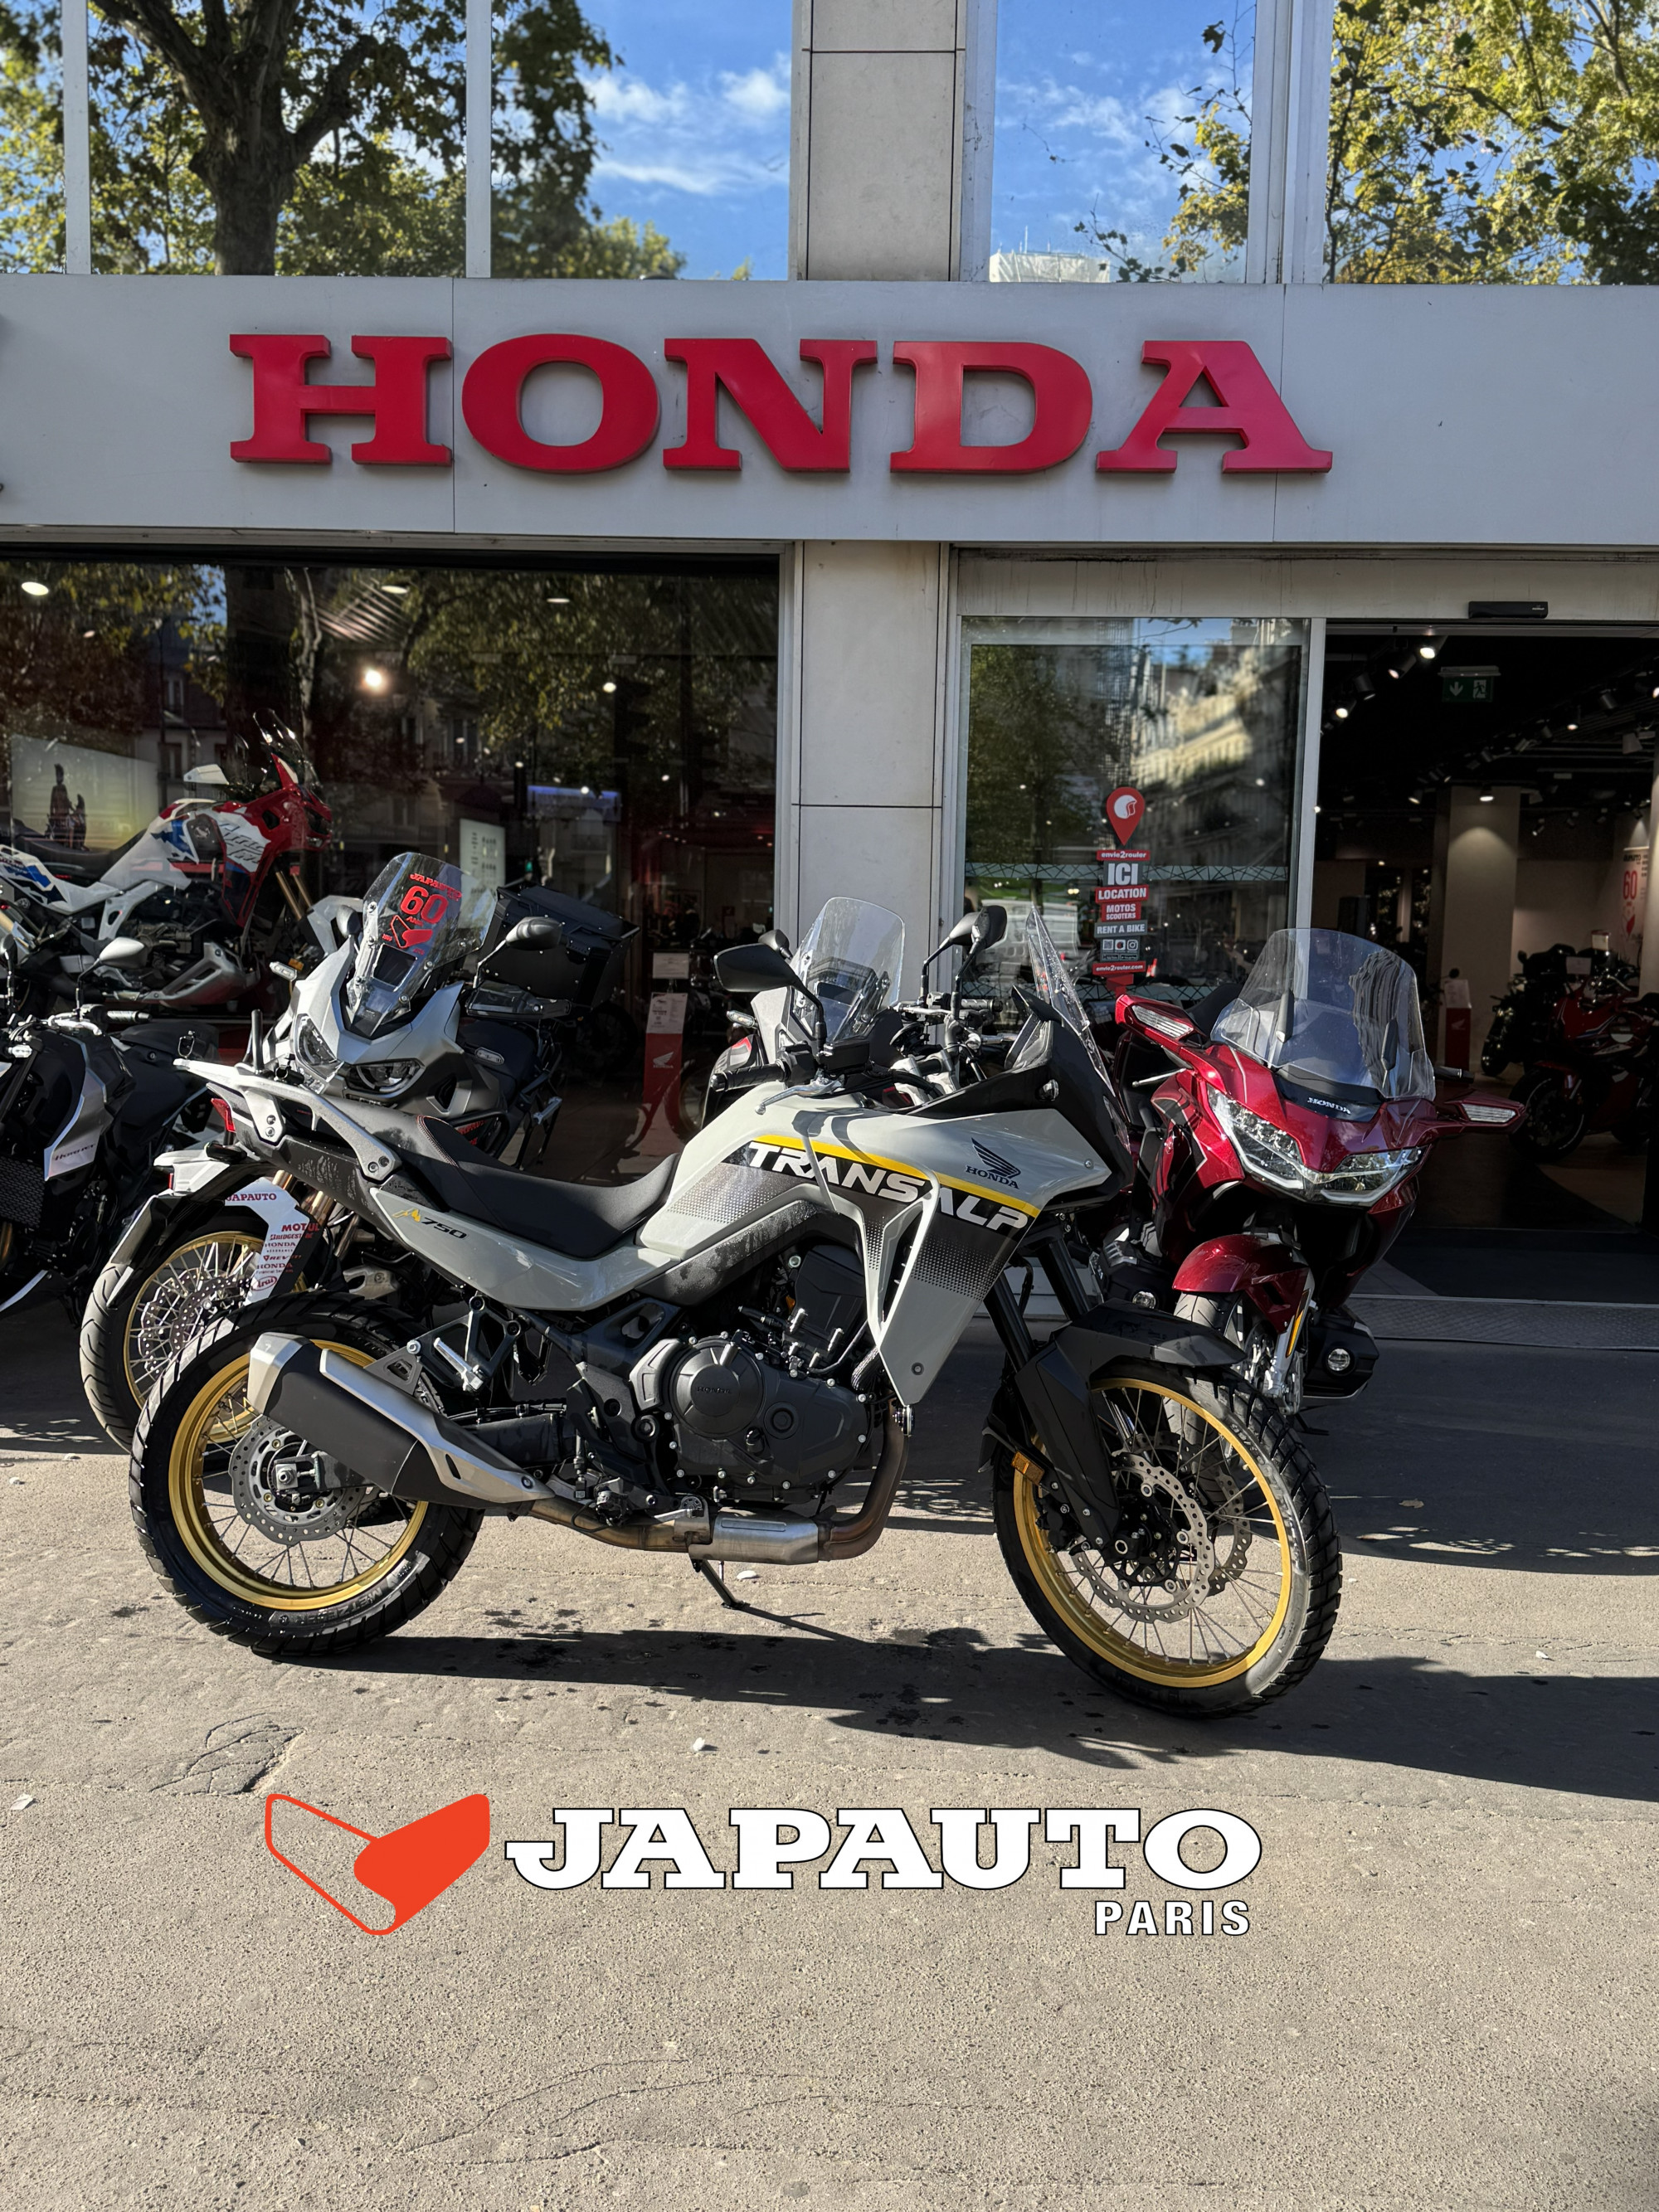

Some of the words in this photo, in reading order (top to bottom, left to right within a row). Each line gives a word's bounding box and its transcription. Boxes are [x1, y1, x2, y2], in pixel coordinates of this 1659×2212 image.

[230, 333, 1333, 474] HONDA
[1101, 850, 1146, 858] envie2rouler
[1107, 863, 1138, 885] ICI
[1097, 887, 1146, 900] LOCATION
[1623, 870, 1637, 900] 60
[400, 885, 449, 924] 60
[1106, 903, 1136, 913] MOTOS
[1106, 912, 1136, 921] SCOOTERS
[1097, 926, 1117, 935] RENT
[1118, 925, 1125, 933] A
[1126, 923, 1146, 933] BIKE
[1306, 1096, 1351, 1115] HONDA
[965, 1164, 1019, 1189] HONDA
[281, 1223, 319, 1232] MOTUL
[421, 1217, 467, 1239] 750
